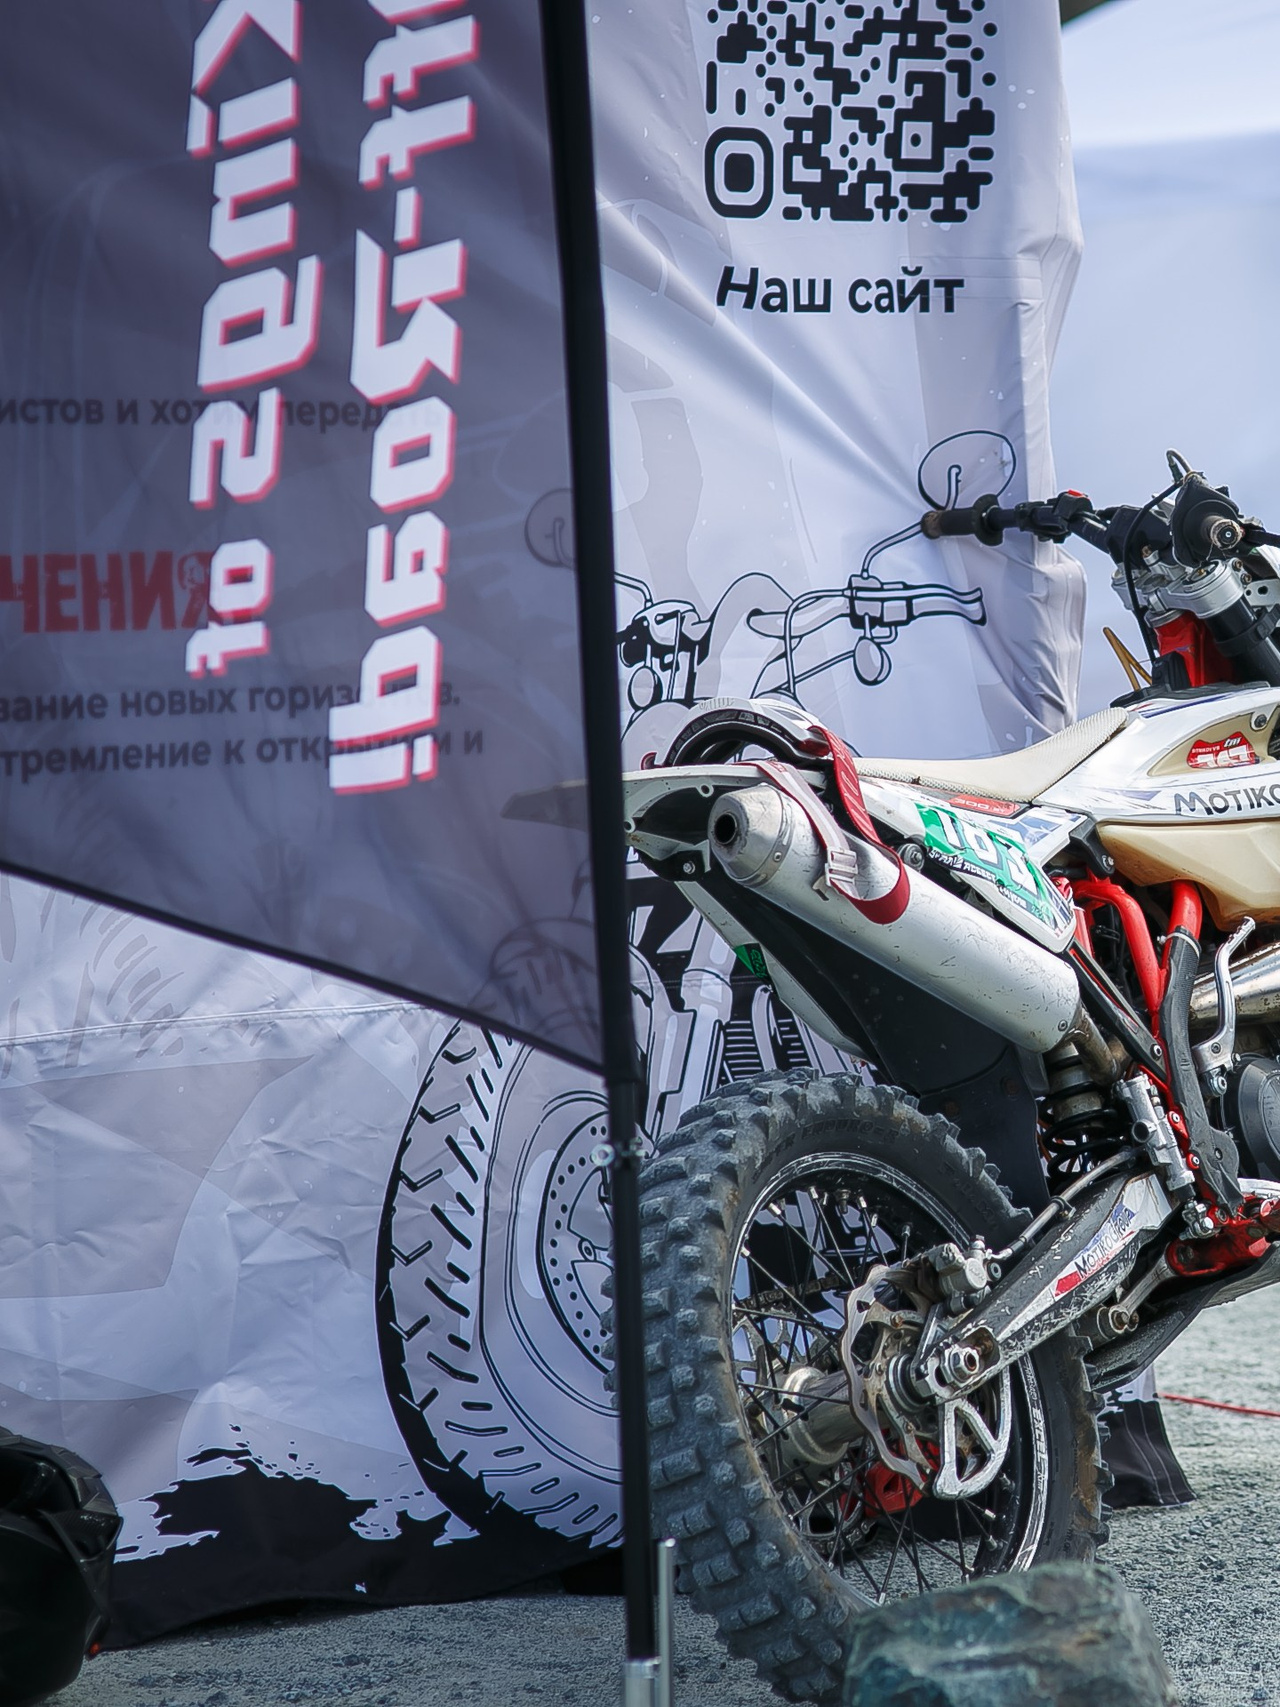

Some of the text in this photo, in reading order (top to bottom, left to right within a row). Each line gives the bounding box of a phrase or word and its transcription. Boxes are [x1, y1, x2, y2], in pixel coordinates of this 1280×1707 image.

[716, 265, 965, 313] Наш сайт
[120, 687, 237, 718] новых
[1032, 1407, 1047, 1466] EXCEL
